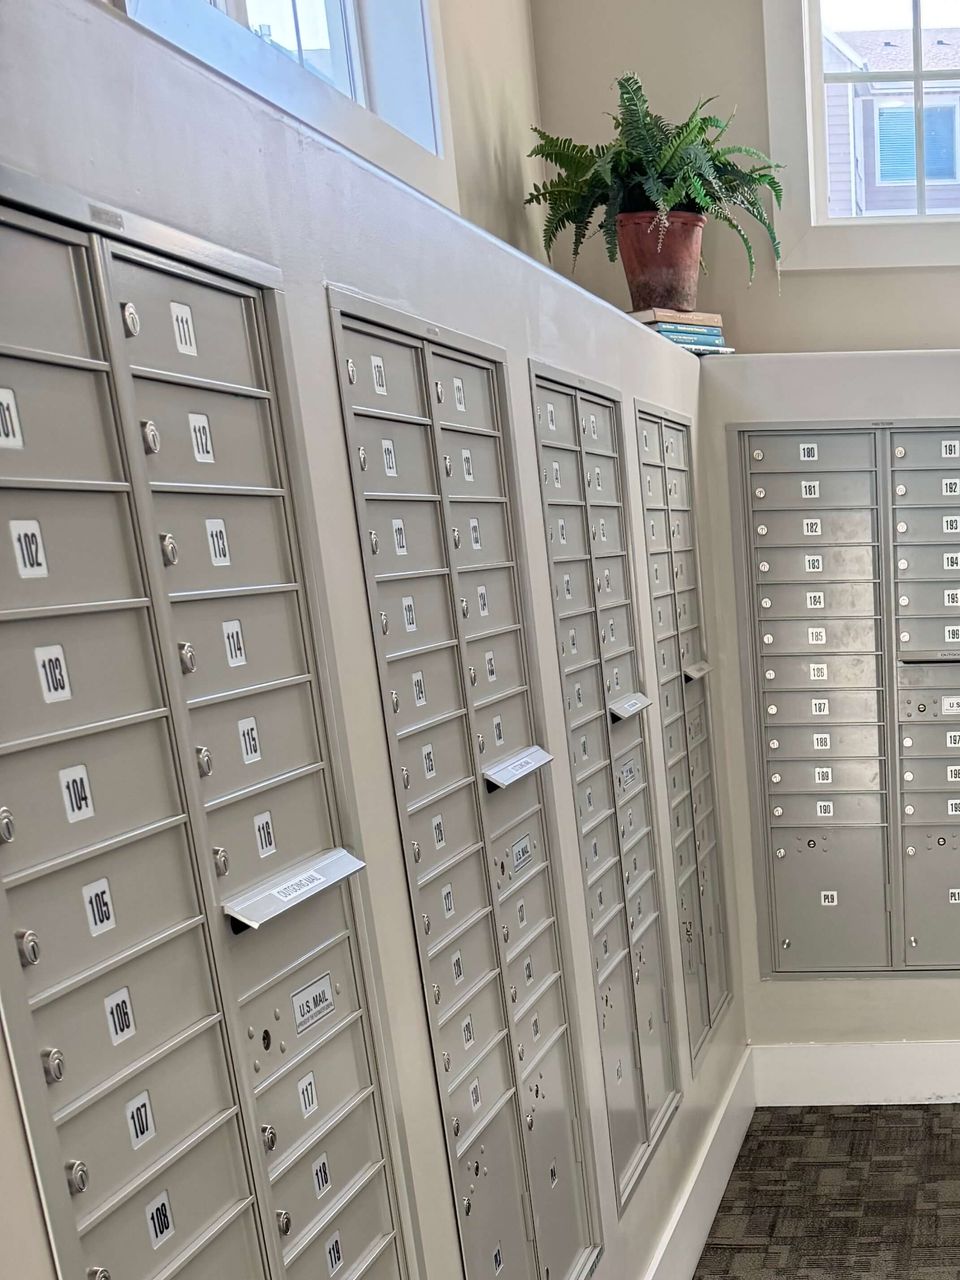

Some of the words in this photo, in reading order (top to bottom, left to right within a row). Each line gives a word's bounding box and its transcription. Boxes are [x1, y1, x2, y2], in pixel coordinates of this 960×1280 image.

[175, 314, 193, 347] 111
[0, 402, 16, 438] 01
[193, 425, 211, 455] 112
[802, 446, 816, 458] 180
[944, 444, 956, 456] 191
[804, 484, 816, 496] 181
[944, 482, 958, 493] 192
[806, 522, 818, 533] 182
[945, 519, 958, 530] 193
[17, 532, 42, 568] 102
[210, 529, 227, 558] 113
[807, 558, 820, 570] 183
[946, 556, 959, 568] 194
[809, 595, 822, 606] 184
[226, 630, 243, 659] 114
[42, 657, 66, 692] 103
[814, 702, 826, 713] 187
[242, 727, 258, 756] 115
[816, 737, 828, 748] 188
[949, 734, 960, 745] 197
[66, 777, 89, 812] 104
[819, 804, 831, 815] 190
[257, 820, 273, 850] 116
[88, 890, 111, 926] 105
[110, 999, 131, 1036] 106
[299, 1000, 313, 1018] U.S.
[312, 989, 329, 1010] MAIL
[301, 1081, 314, 1110] 117
[130, 1102, 149, 1139] 107
[315, 1162, 329, 1191] 118
[150, 1202, 170, 1239] 108
[328, 1239, 341, 1269] 119
